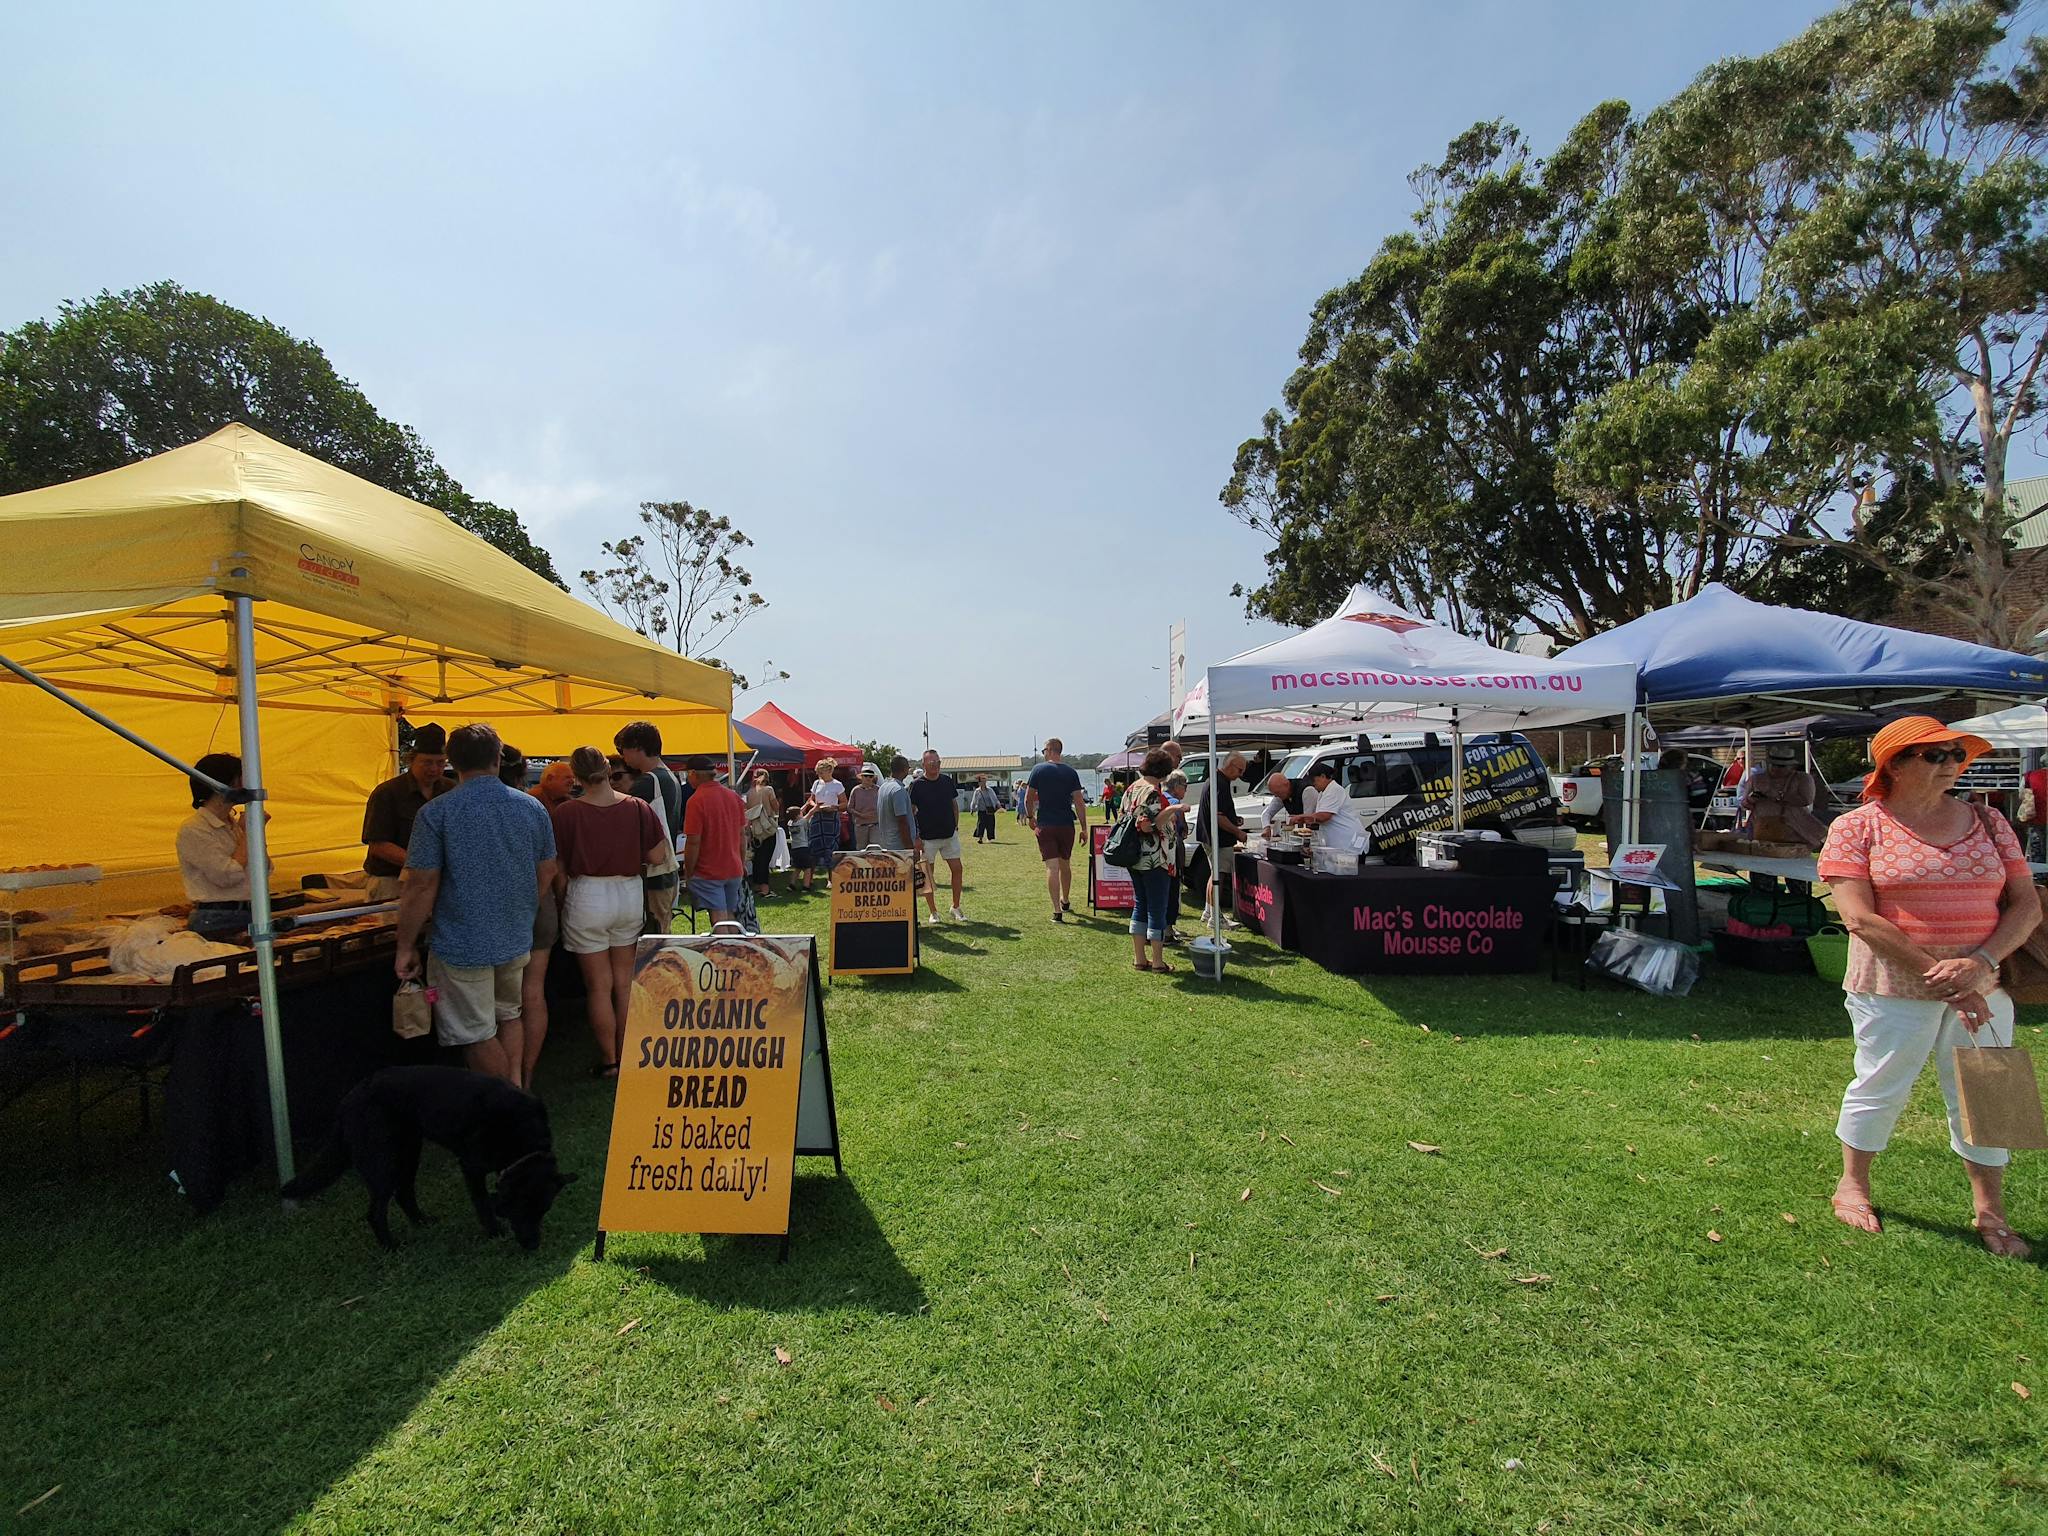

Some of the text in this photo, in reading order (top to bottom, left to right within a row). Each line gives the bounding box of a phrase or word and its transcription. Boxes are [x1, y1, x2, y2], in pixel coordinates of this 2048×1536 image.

[1271, 671, 1583, 692] macsmousse.com.au
[1465, 745, 1489, 764] FOR
[1371, 817, 1402, 838] Muir
[1403, 804, 1446, 826] Place,
[840, 880, 906, 893] SOURDOUGH
[851, 867, 896, 880] ARTISAN
[838, 907, 907, 920] Today's Specials
[855, 895, 890, 907] BREAD
[1353, 904, 1524, 931] Mac's Chocolate
[1383, 930, 1494, 955] Mousse Co
[699, 961, 741, 992] Our
[663, 998, 769, 1030] ORGANIC
[638, 1036, 785, 1069] SOURDOUGH
[667, 1075, 748, 1109] BREAD
[652, 1115, 752, 1150] is baked
[628, 1155, 769, 1202] fresh daily!
